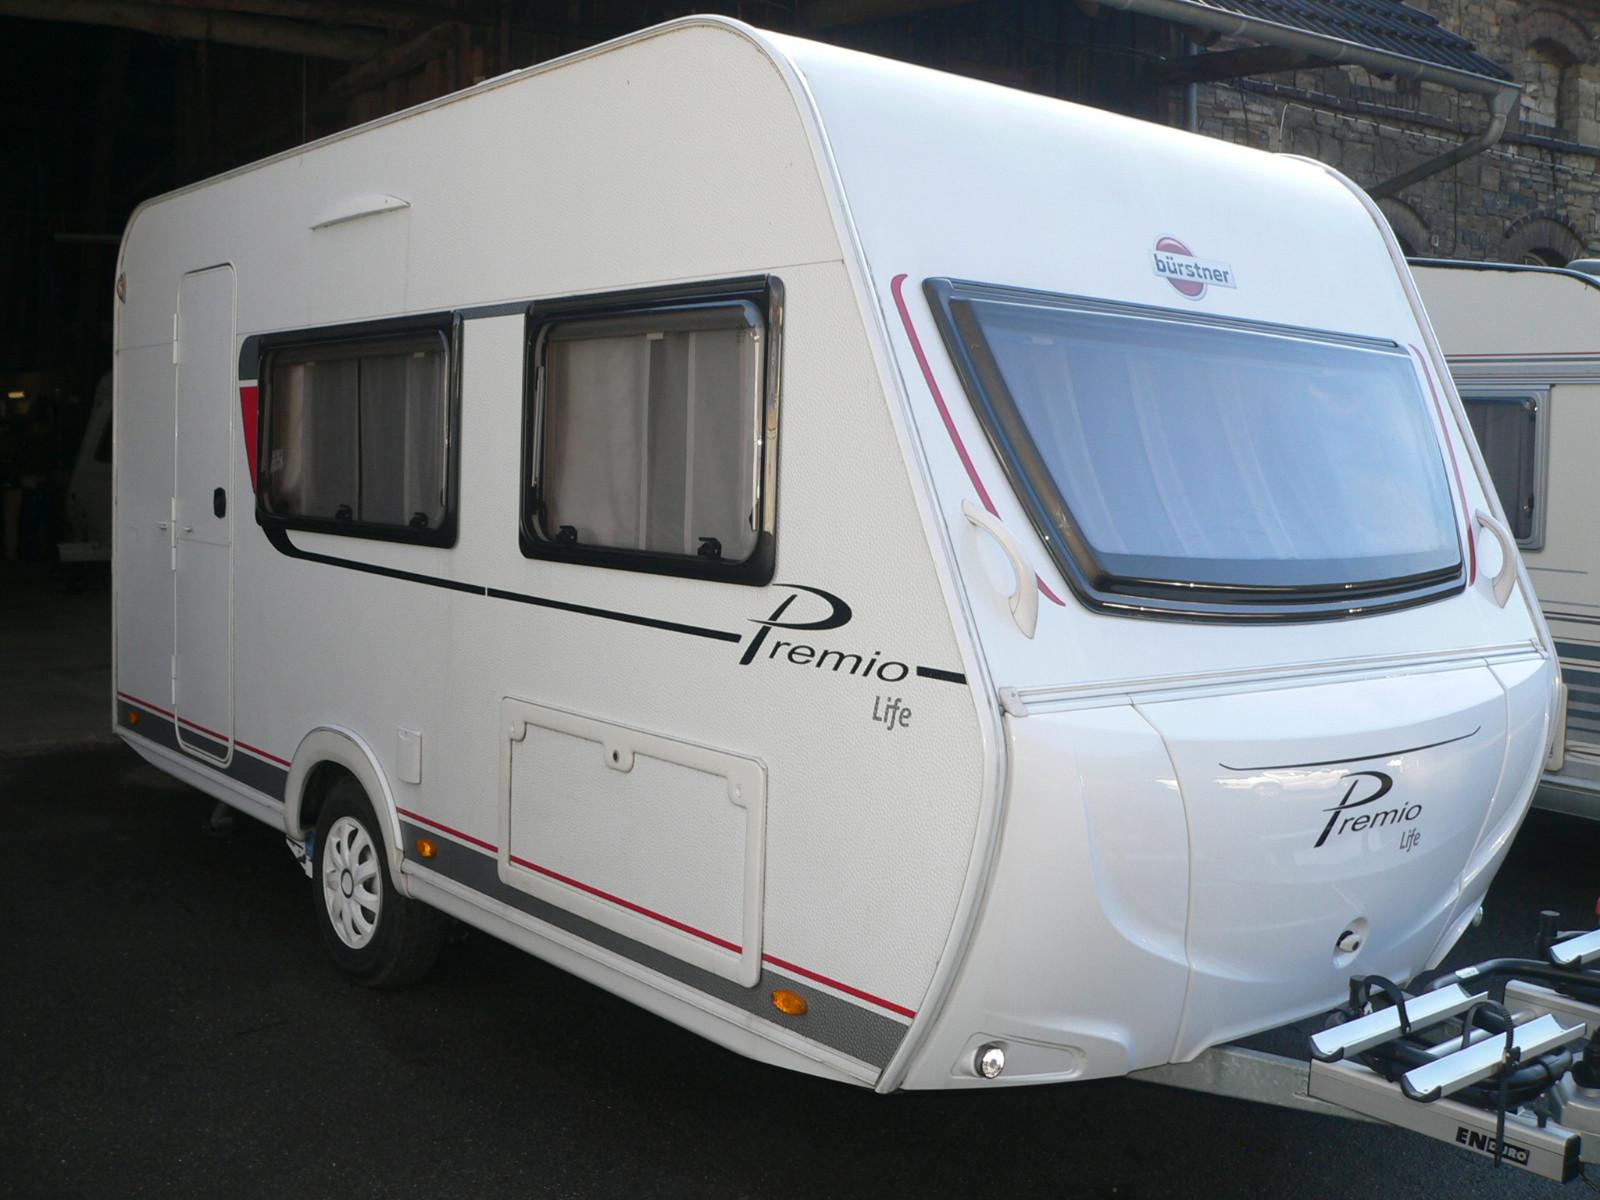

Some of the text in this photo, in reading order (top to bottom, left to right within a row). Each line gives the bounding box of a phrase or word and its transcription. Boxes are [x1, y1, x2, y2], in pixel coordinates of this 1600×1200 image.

[1153, 253, 1230, 283] bürstner
[738, 583, 909, 682] Premio
[872, 695, 912, 731] Life
[1313, 770, 1423, 848] Premio
[1399, 827, 1421, 853] Life
